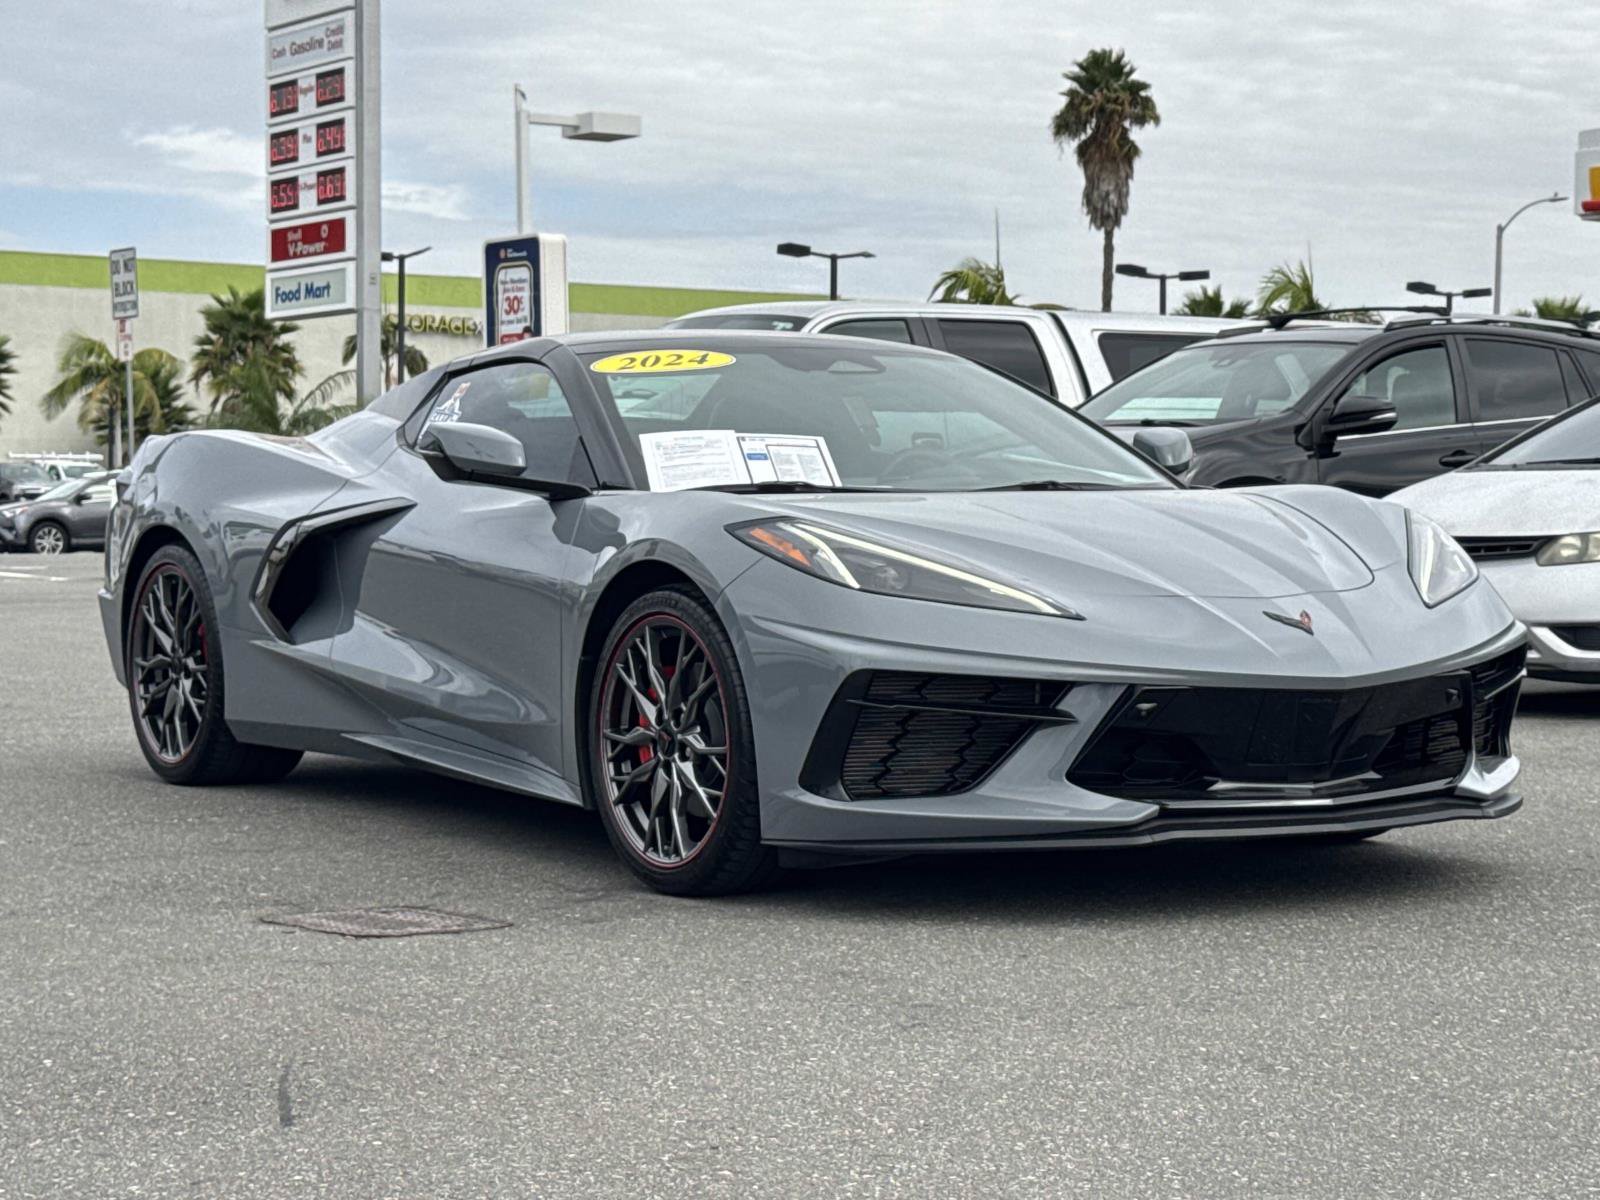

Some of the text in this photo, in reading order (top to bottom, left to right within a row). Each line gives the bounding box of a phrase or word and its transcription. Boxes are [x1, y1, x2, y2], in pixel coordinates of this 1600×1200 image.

[290, 37, 324, 56] Gasoline
[275, 281, 331, 304] Food Mart
[617, 353, 709, 370] 2024
